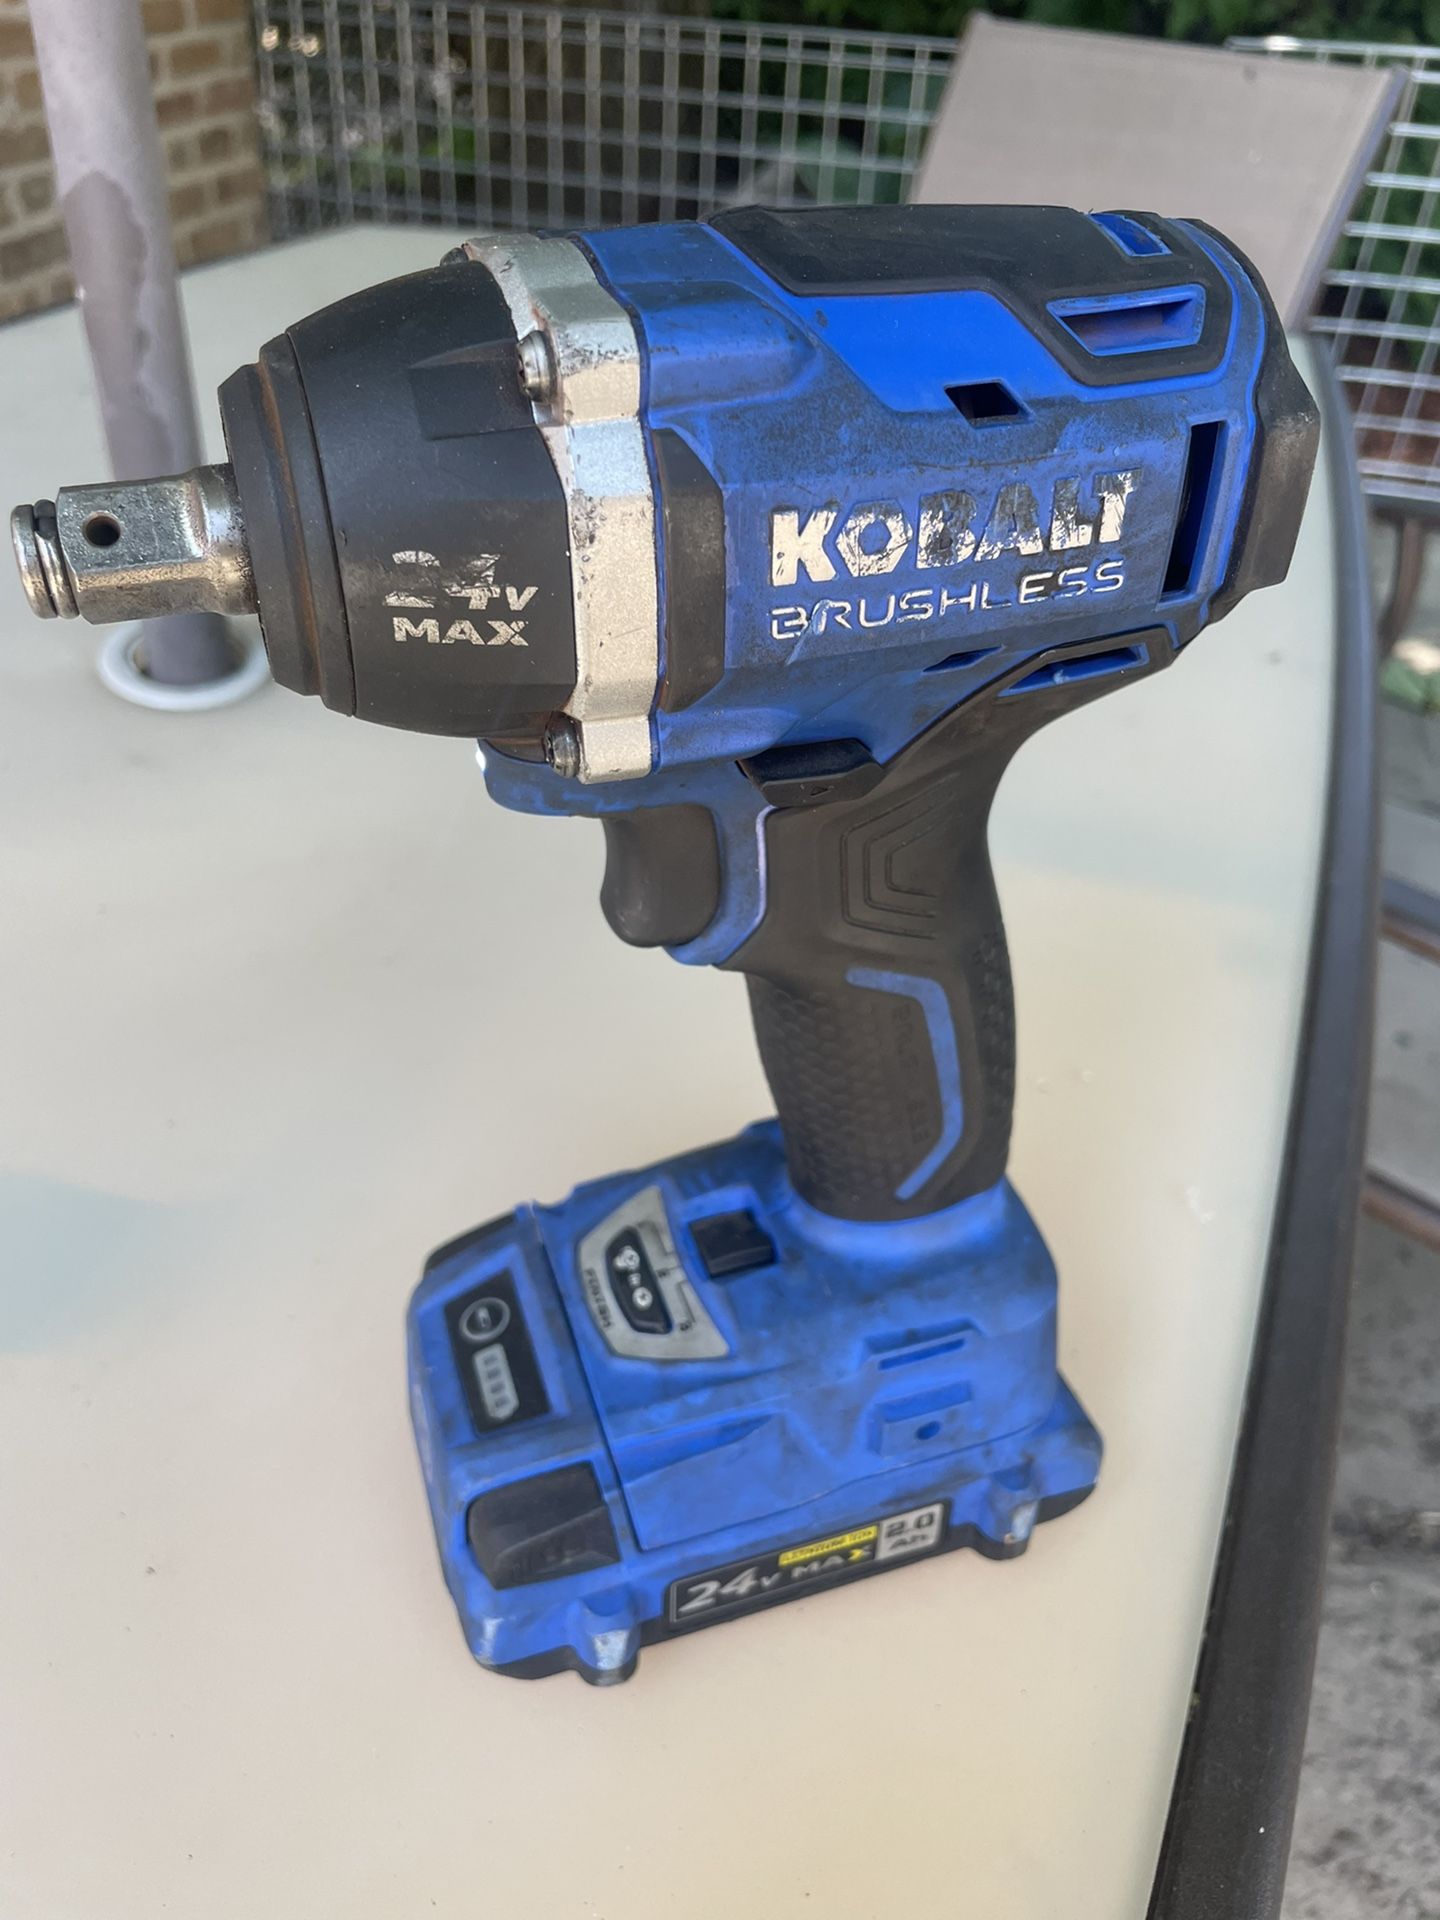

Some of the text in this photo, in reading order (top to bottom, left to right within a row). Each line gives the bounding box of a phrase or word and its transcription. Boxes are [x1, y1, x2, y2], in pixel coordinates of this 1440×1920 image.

[770, 468, 1139, 587] KOBALT
[771, 560, 1124, 640] BRUSHLESS
[392, 616, 530, 647] MAX
[886, 1512, 935, 1538] 2.0
[792, 1545, 872, 1578] MAX
